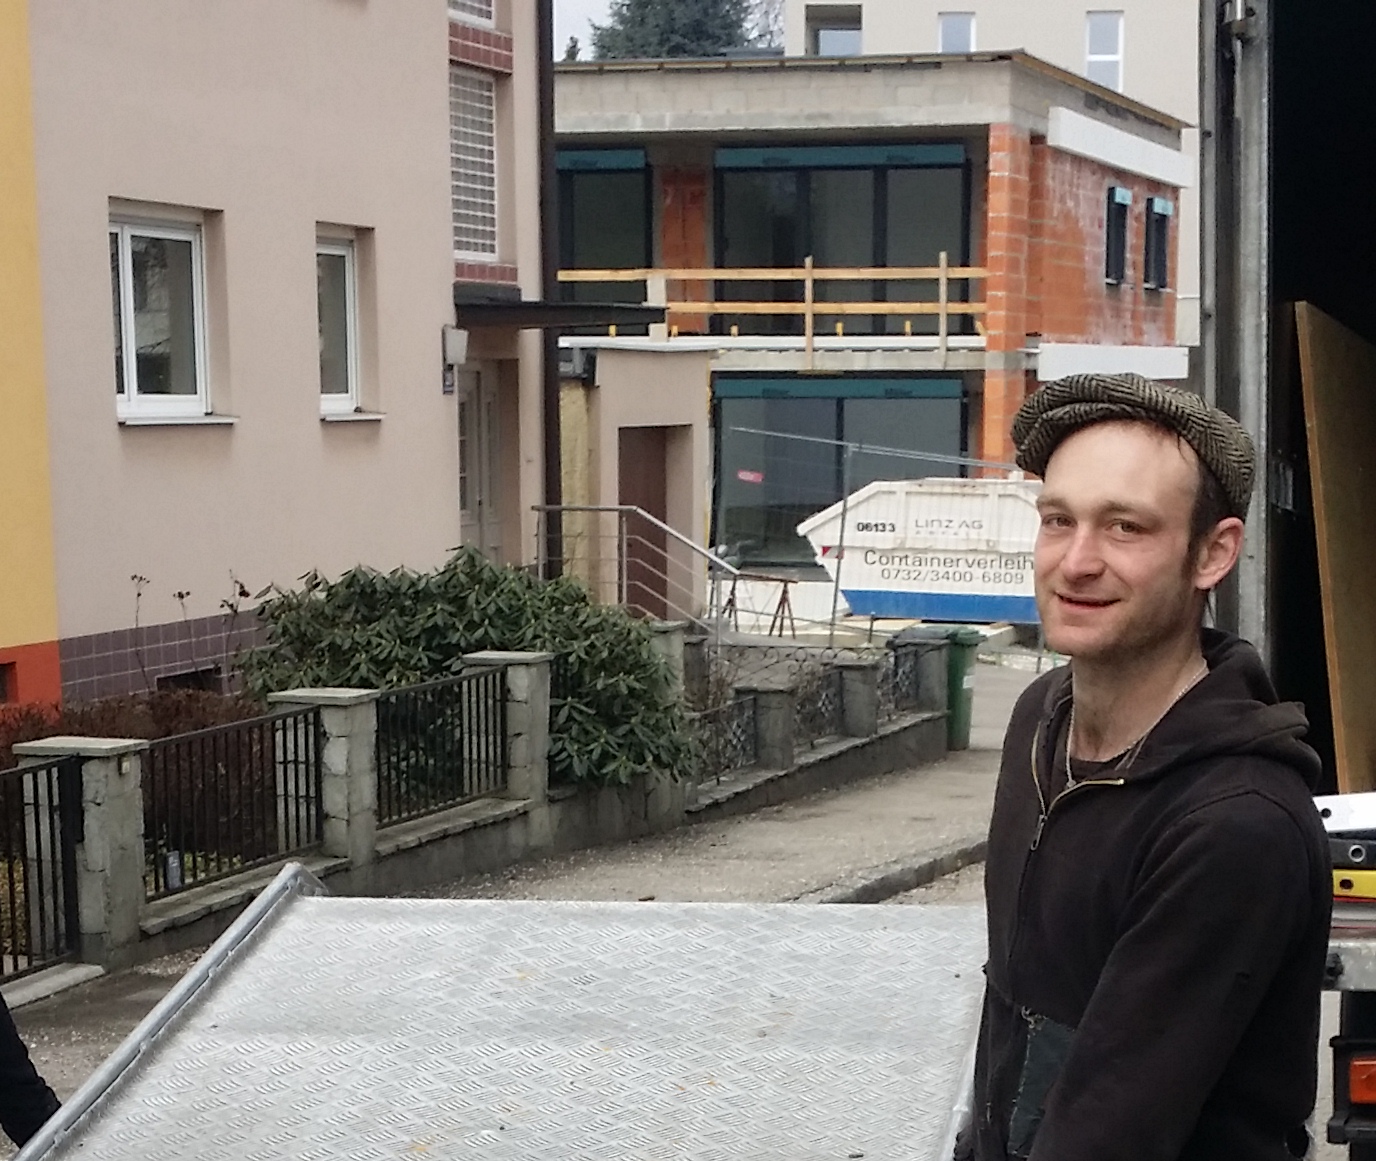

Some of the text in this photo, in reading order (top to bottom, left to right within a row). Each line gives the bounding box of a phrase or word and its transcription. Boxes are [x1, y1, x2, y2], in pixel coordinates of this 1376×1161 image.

[856, 522, 896, 532] 06133
[958, 519, 984, 530] AG
[863, 549, 1035, 571] Containerverleih
[880, 567, 1025, 585] 0732/3400-6809
